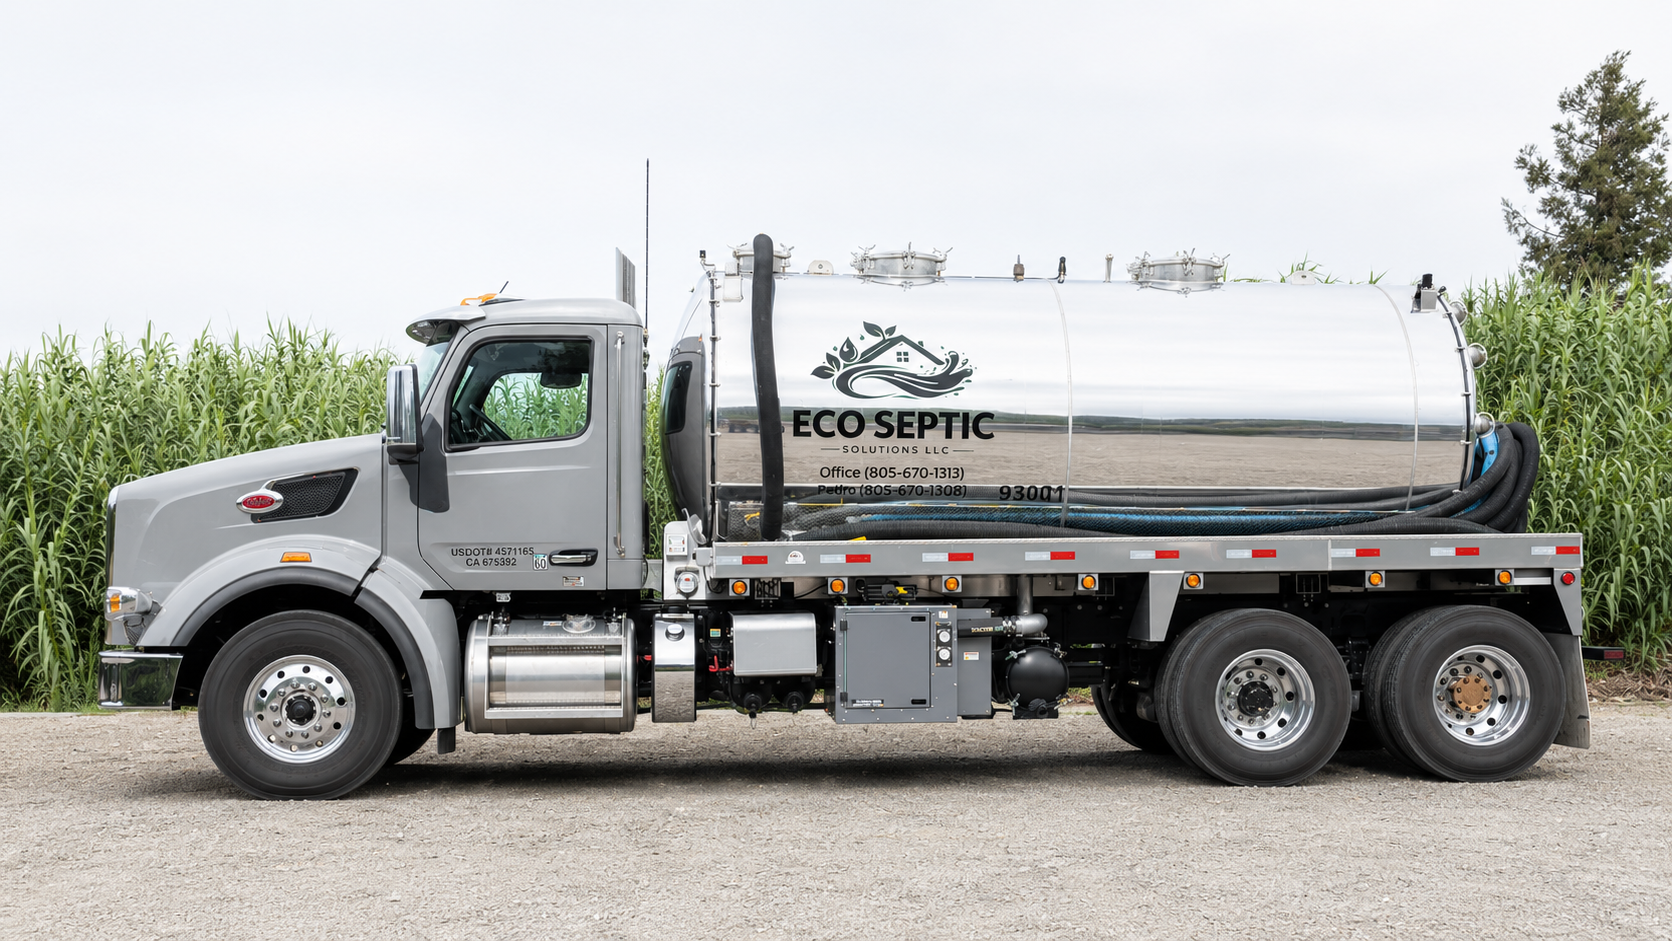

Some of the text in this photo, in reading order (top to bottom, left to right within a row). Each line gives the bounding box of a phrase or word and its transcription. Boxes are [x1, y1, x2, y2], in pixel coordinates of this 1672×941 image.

[793, 410, 995, 440] ECO SEPTIC
[842, 445, 949, 455] SOLUTIONS LLC
[820, 466, 965, 481] Office (805-670-1313)
[817, 484, 967, 498] Pedro (805-670-1308)
[999, 485, 1064, 502] 93001
[451, 547, 493, 557] USDOT#
[465, 557, 517, 567] CA 675392
